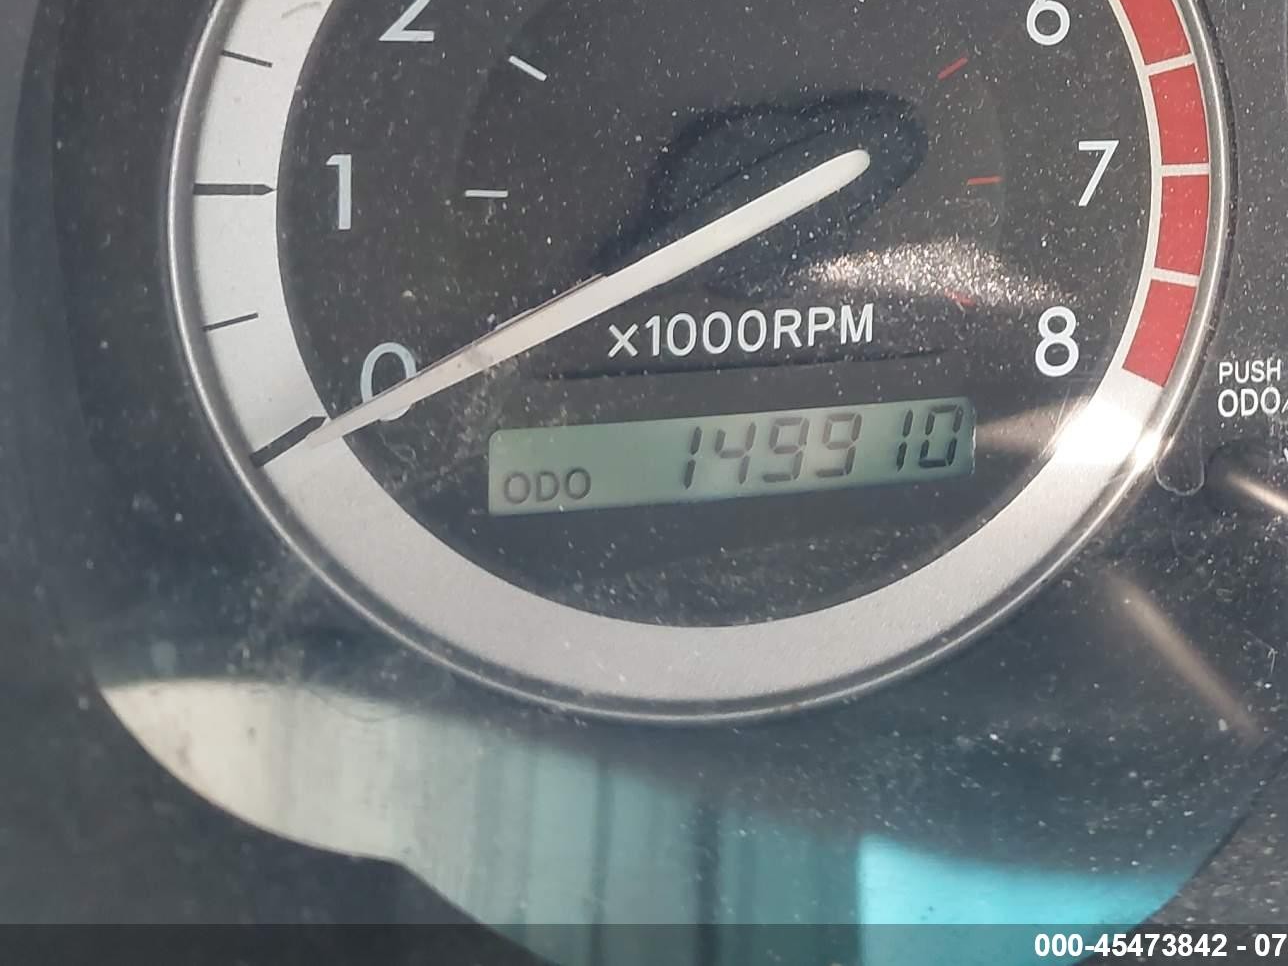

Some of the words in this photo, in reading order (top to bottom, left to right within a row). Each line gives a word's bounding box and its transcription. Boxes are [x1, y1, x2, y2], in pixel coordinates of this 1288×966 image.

[326, 154, 352, 230] 1
[1078, 140, 1119, 206] 7
[1035, 306, 1079, 377] 8
[1218, 359, 1281, 384] PUSH
[360, 342, 416, 421] 0
[503, 468, 591, 505] ODO
[682, 403, 964, 490] 149910
